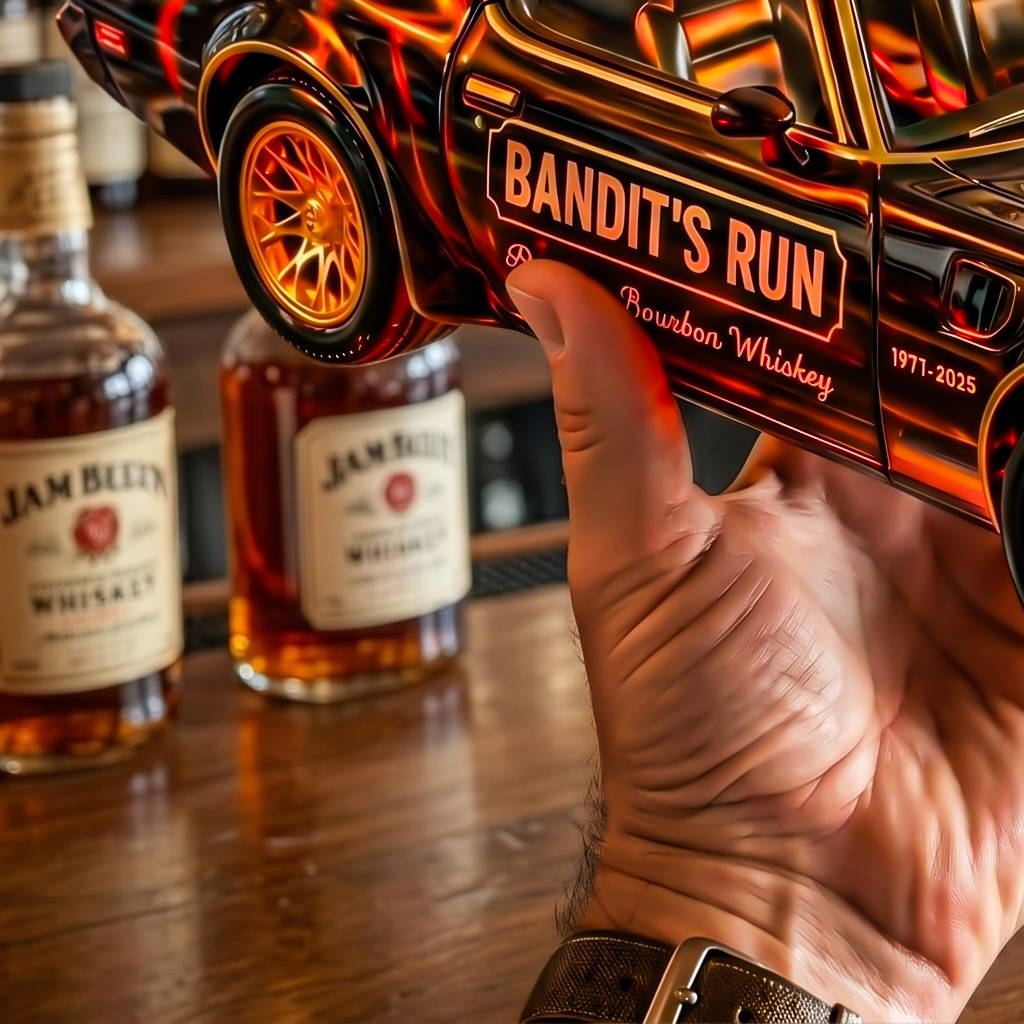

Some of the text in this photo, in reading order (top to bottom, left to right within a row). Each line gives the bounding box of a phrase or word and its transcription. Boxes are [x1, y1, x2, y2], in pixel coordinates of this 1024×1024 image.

[504, 138, 826, 318] BANDIT'S RUN
[620, 285, 835, 402] Bourbon Whiskey
[0, 470, 73, 525] JAM
[30, 574, 157, 617] WHISKEY
